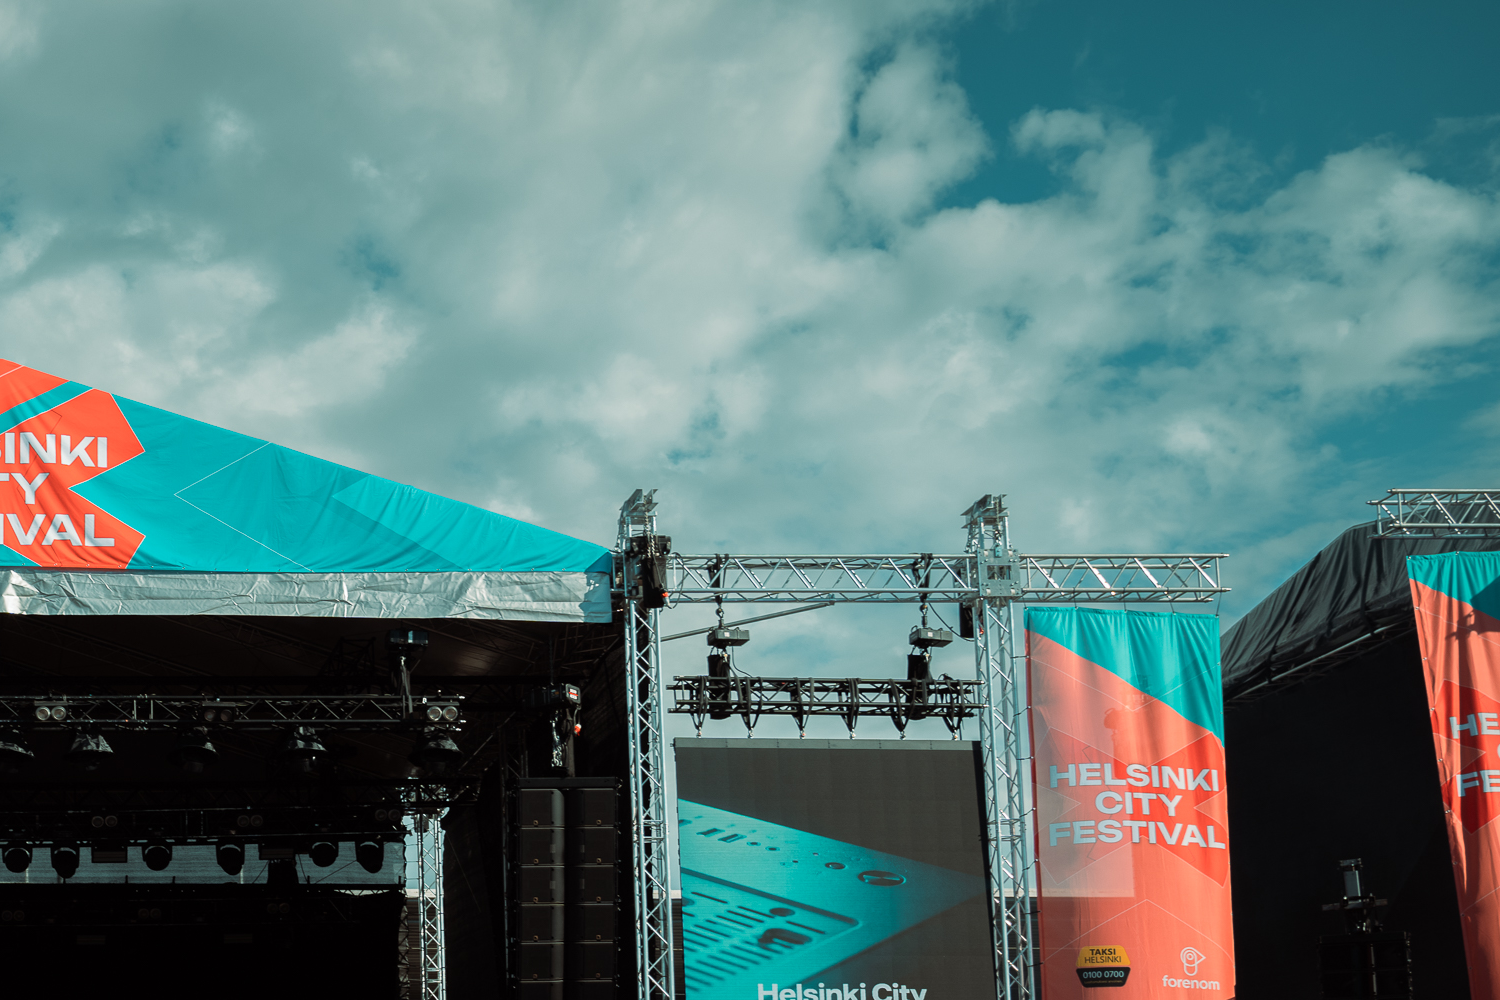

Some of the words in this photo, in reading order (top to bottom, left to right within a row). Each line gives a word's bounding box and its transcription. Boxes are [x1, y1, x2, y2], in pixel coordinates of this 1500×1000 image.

[1050, 763, 1219, 792] HELSINKI
[1095, 791, 1183, 817] CITY
[1050, 819, 1226, 850] FESTIVAL
[1089, 948, 1116, 956] TAKSI
[1084, 956, 1122, 964] HELSINKI
[1082, 971, 1102, 979] 0100
[1104, 970, 1125, 978] 0700
[1162, 975, 1220, 990] forenom
